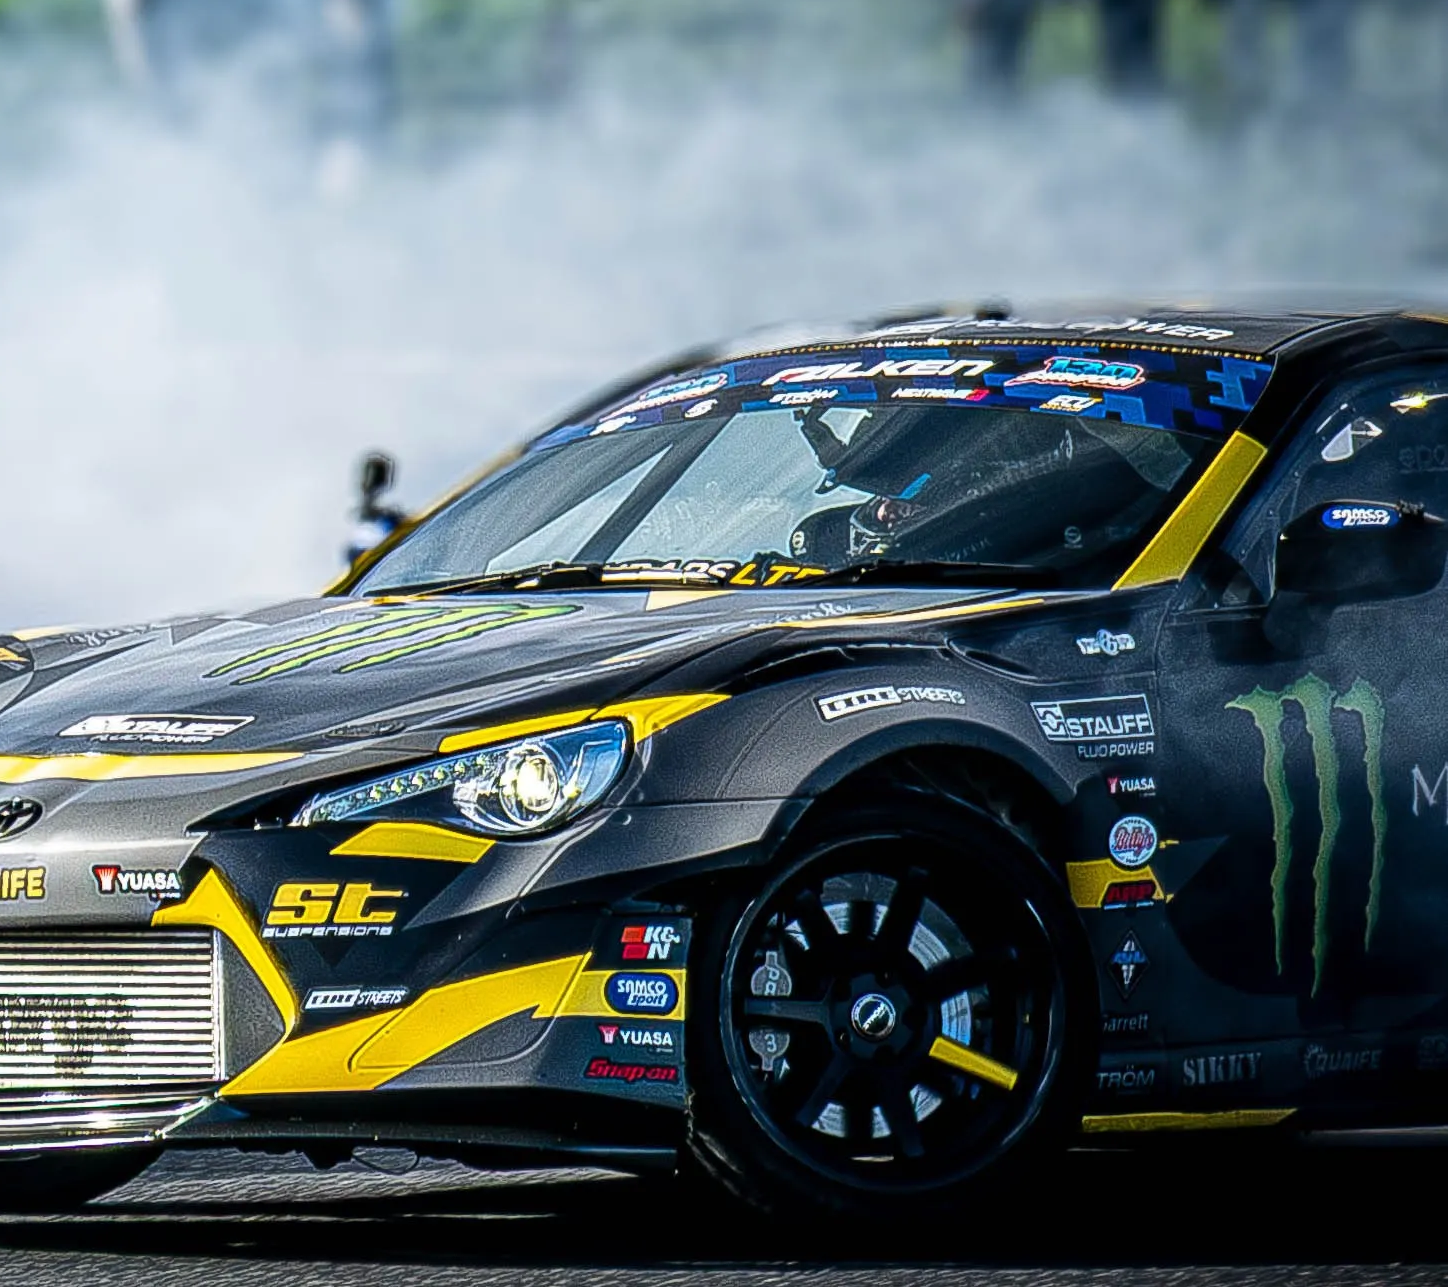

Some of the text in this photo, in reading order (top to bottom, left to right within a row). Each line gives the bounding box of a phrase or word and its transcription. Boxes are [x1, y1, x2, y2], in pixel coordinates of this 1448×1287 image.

[1065, 712, 1150, 737] STAUFF
[1109, 741, 1155, 757] POWER
[1119, 776, 1155, 793] YUASA
[116, 870, 180, 891] YUASA
[619, 1030, 674, 1046] YUASA
[1183, 1051, 1263, 1087] SIKKY
